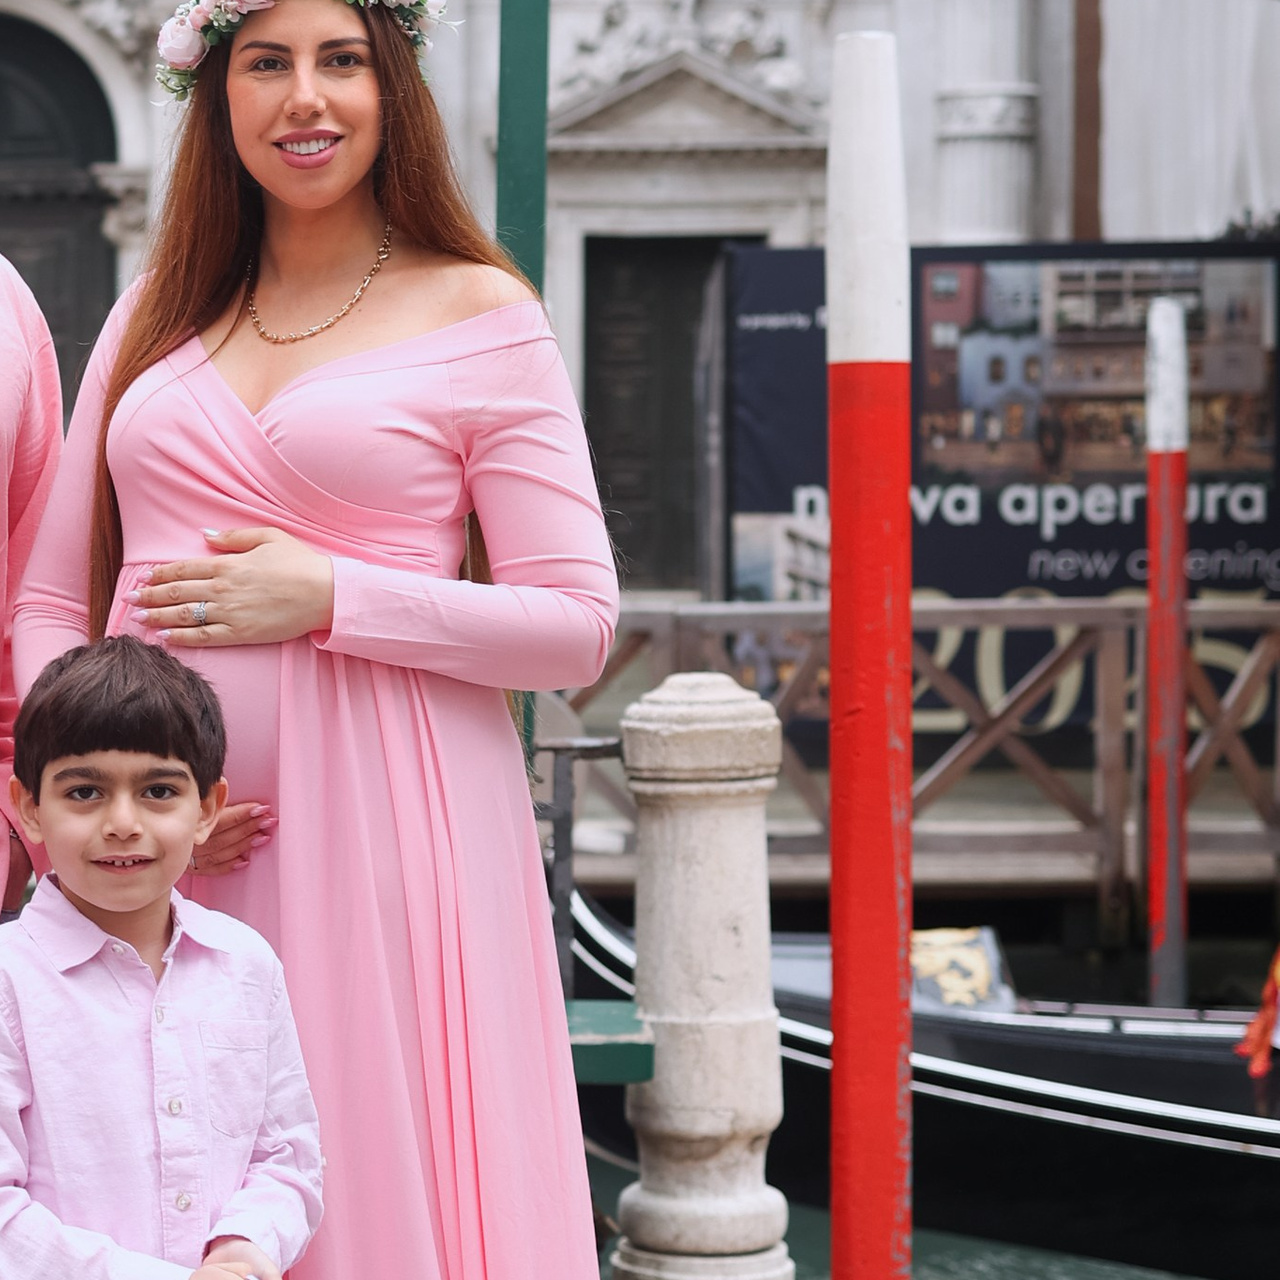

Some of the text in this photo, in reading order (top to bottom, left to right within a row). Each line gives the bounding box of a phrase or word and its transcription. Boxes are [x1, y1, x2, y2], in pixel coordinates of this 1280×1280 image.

[793, 482, 1268, 542] nva aperra
[1028, 540, 1280, 592] new oenin
